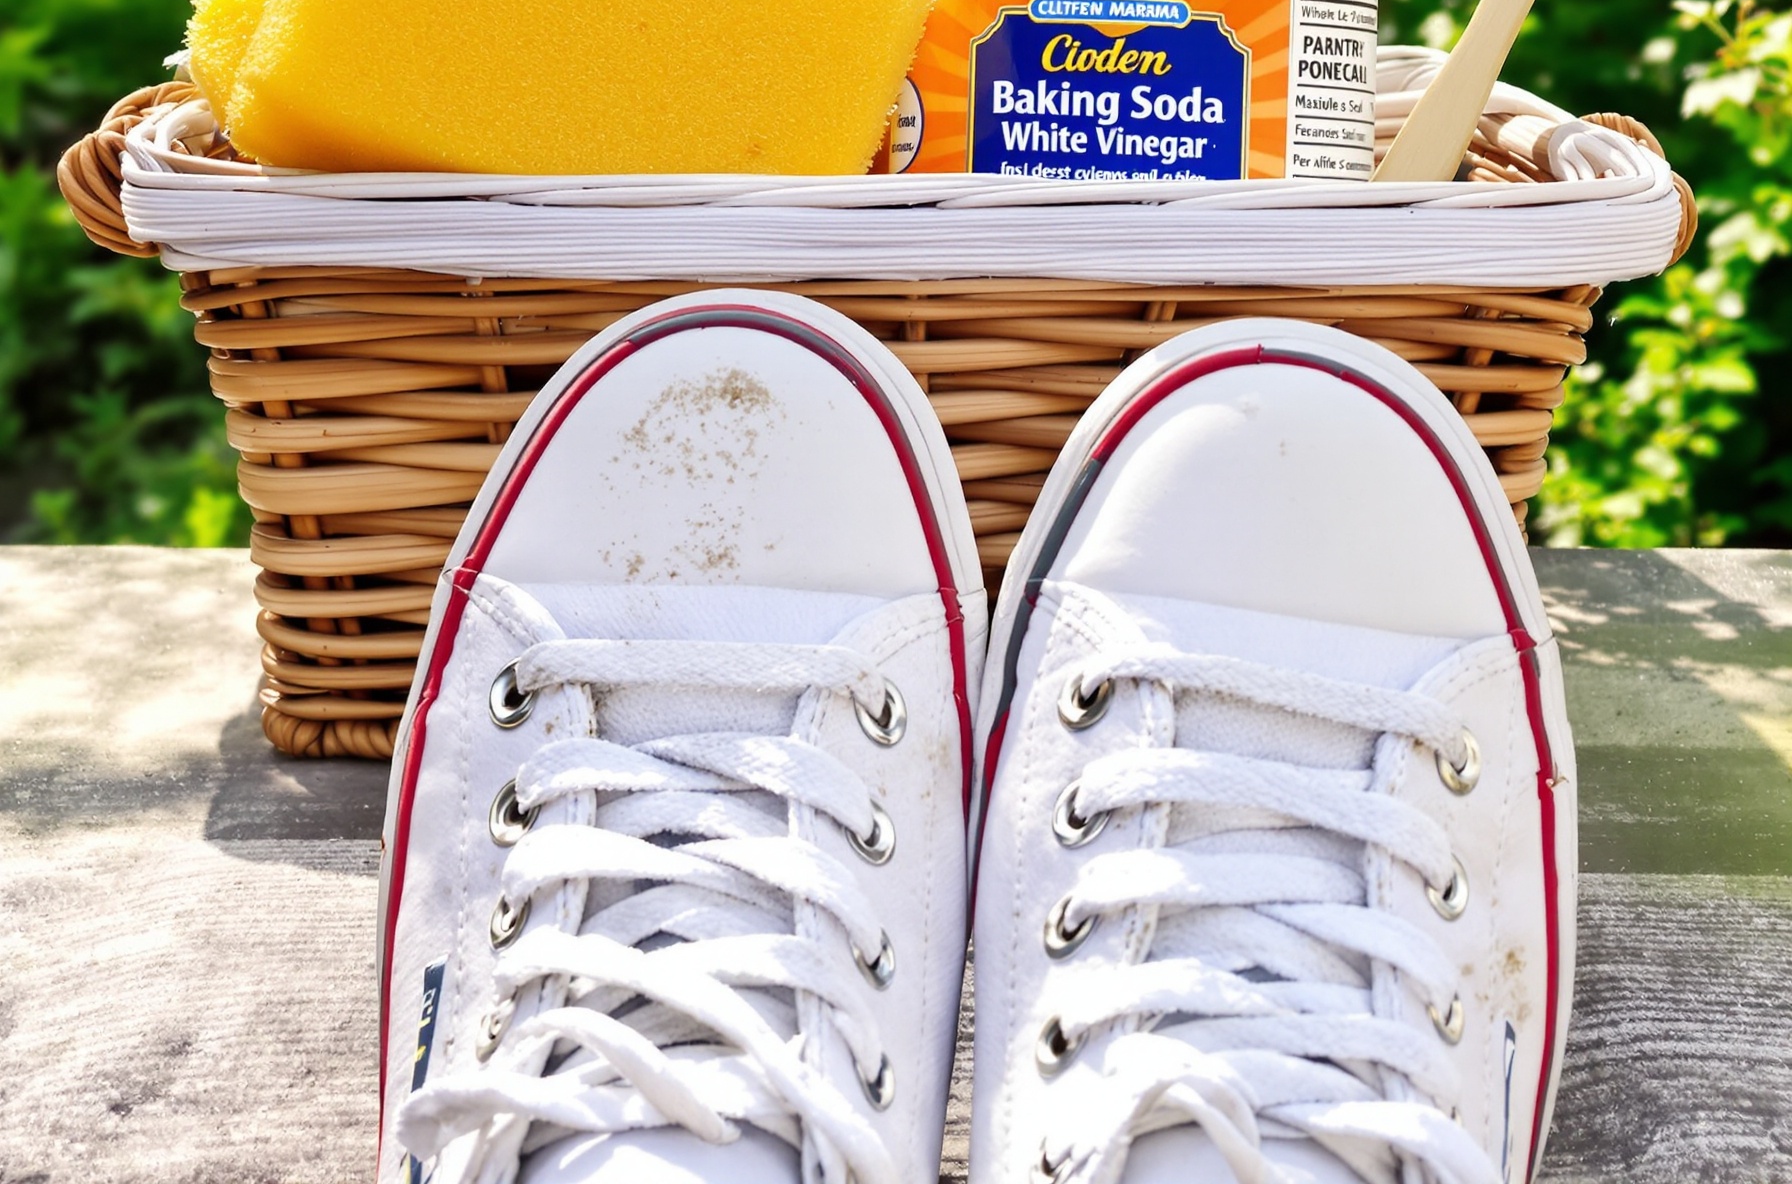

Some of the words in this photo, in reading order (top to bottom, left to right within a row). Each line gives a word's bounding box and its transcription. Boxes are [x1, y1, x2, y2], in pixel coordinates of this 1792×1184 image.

[992, 79, 1120, 126] Baking
[1130, 85, 1225, 123] Soda
[1001, 120, 1088, 154] White
[1096, 126, 1208, 165] Vinegar
